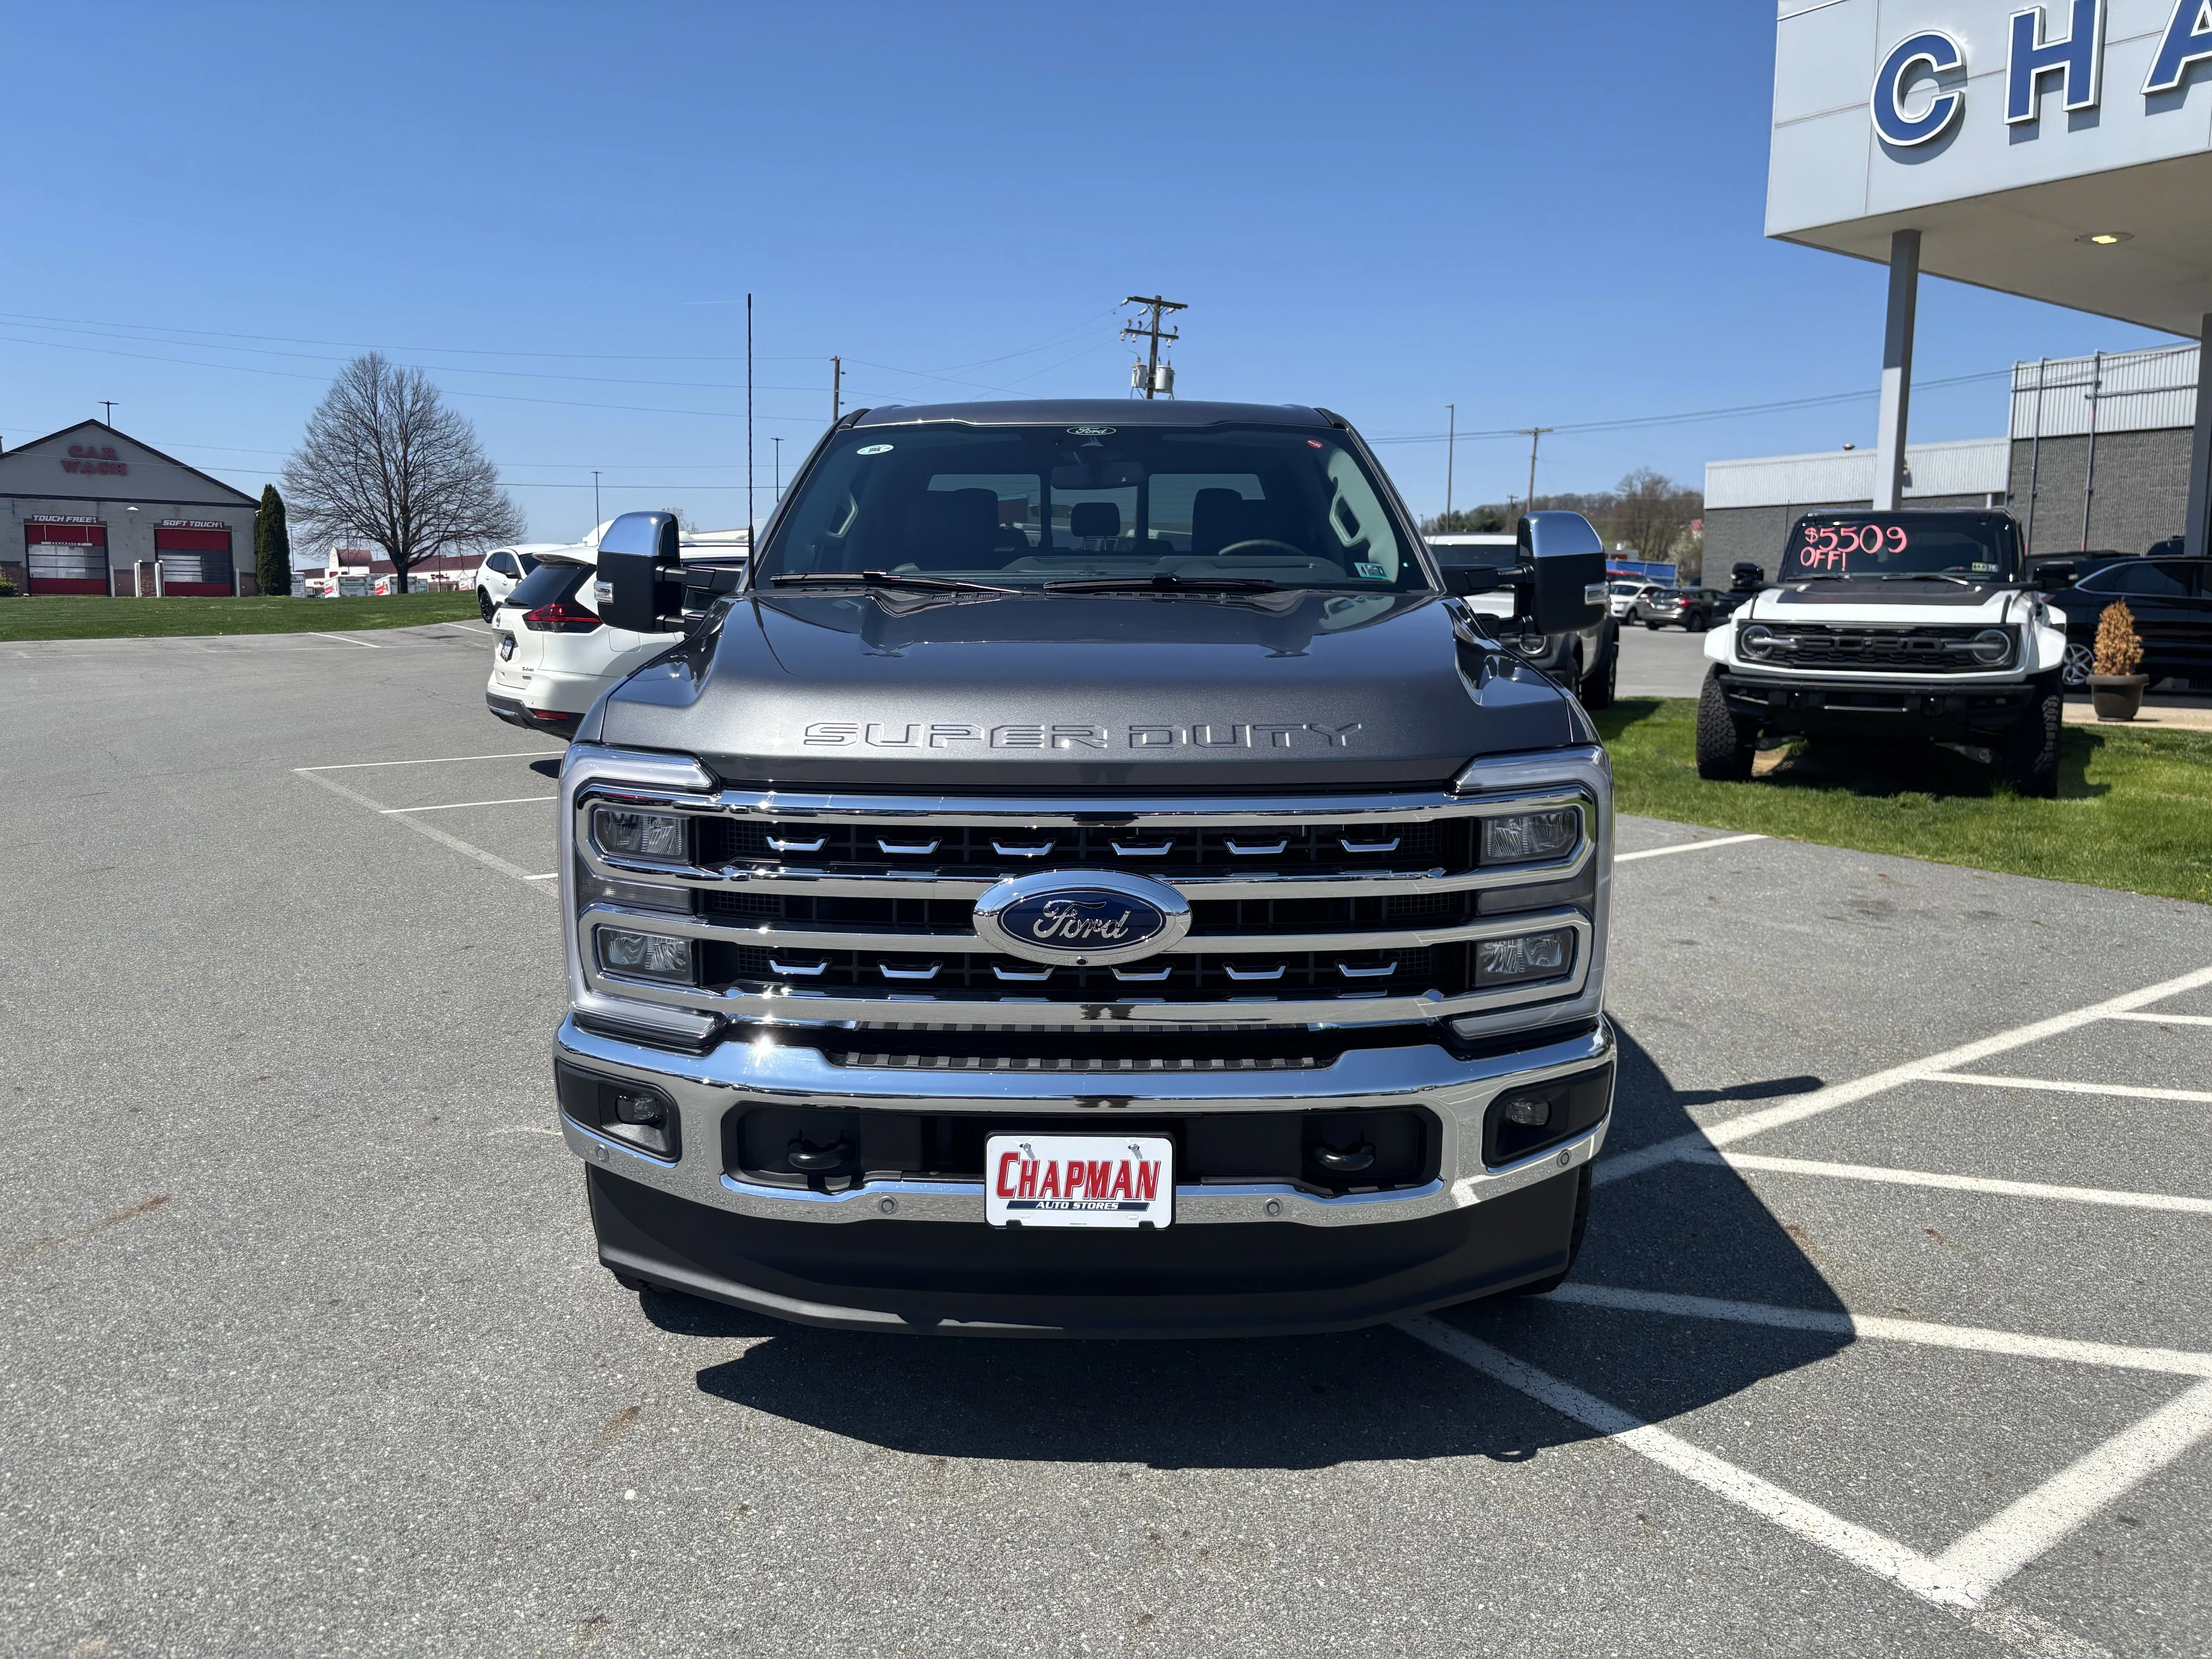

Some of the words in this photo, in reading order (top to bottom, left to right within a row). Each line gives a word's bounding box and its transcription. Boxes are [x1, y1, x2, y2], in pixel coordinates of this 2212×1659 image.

[68, 446, 117, 461] CAR
[60, 460, 127, 476] WASH
[1805, 525, 1907, 554] $5509
[1800, 546, 1846, 572] OFF!
[804, 722, 1107, 749] SUPER
[1128, 723, 1362, 749] DUTY
[1033, 899, 1131, 938] Ford
[995, 1151, 1161, 1200] CHAPMAN
